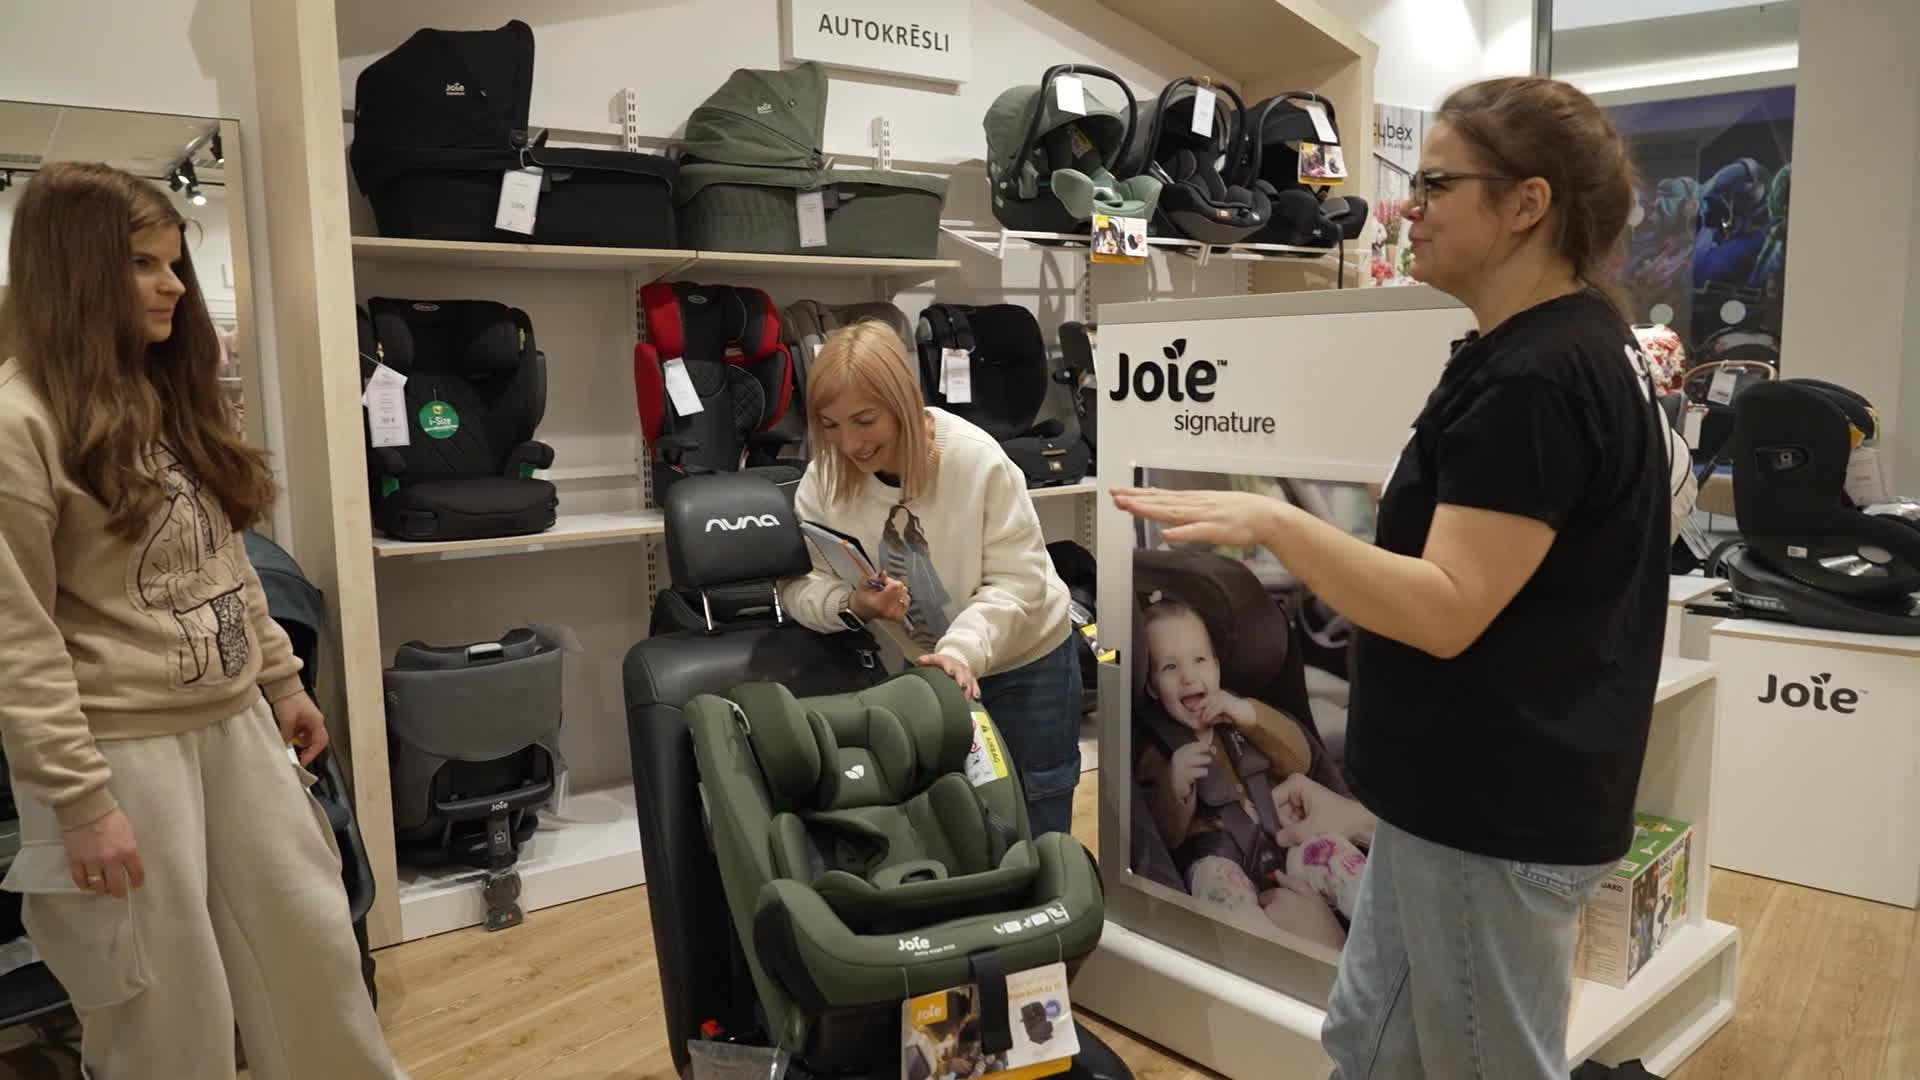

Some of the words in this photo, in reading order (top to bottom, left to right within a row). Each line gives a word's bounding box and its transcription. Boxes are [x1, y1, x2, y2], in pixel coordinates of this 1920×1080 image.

[818, 13, 949, 52] AUTOKRĒSLI
[1174, 409, 1276, 436] signature
[705, 513, 781, 533] nuna
[1757, 672, 1859, 714] Joie
[898, 935, 930, 951] Joie
